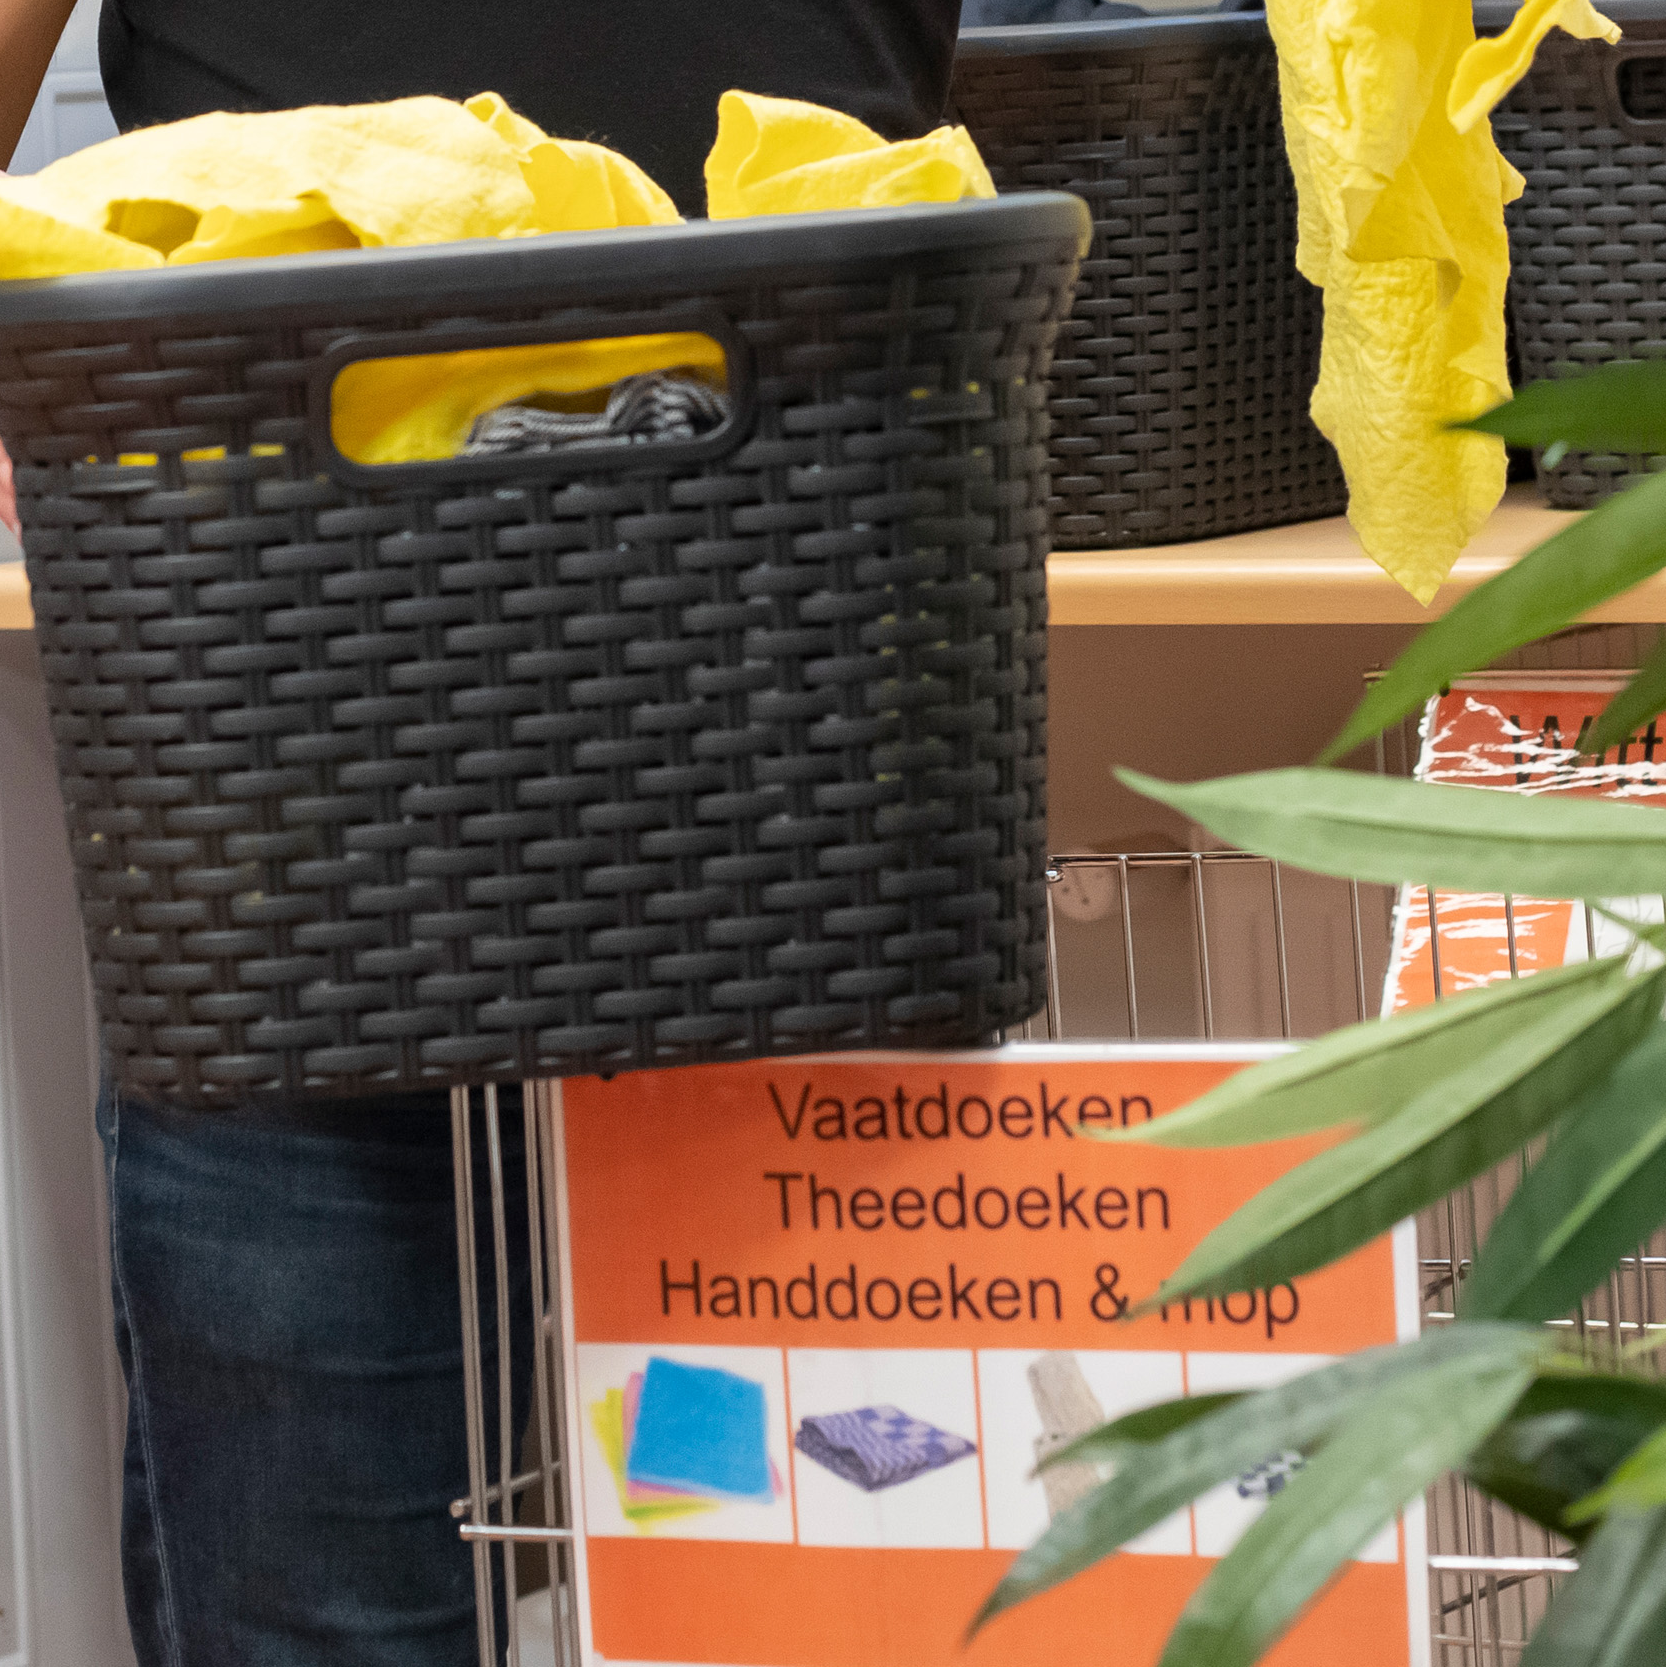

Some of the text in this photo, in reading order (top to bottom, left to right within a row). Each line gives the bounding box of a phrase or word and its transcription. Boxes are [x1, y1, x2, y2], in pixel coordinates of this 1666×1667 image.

[766, 1081, 1155, 1141] Vaatdoeken
[763, 1171, 1170, 1232] Theedoeken
[659, 1258, 1063, 1322] Handdoeken
[1089, 1262, 1131, 1323] &
